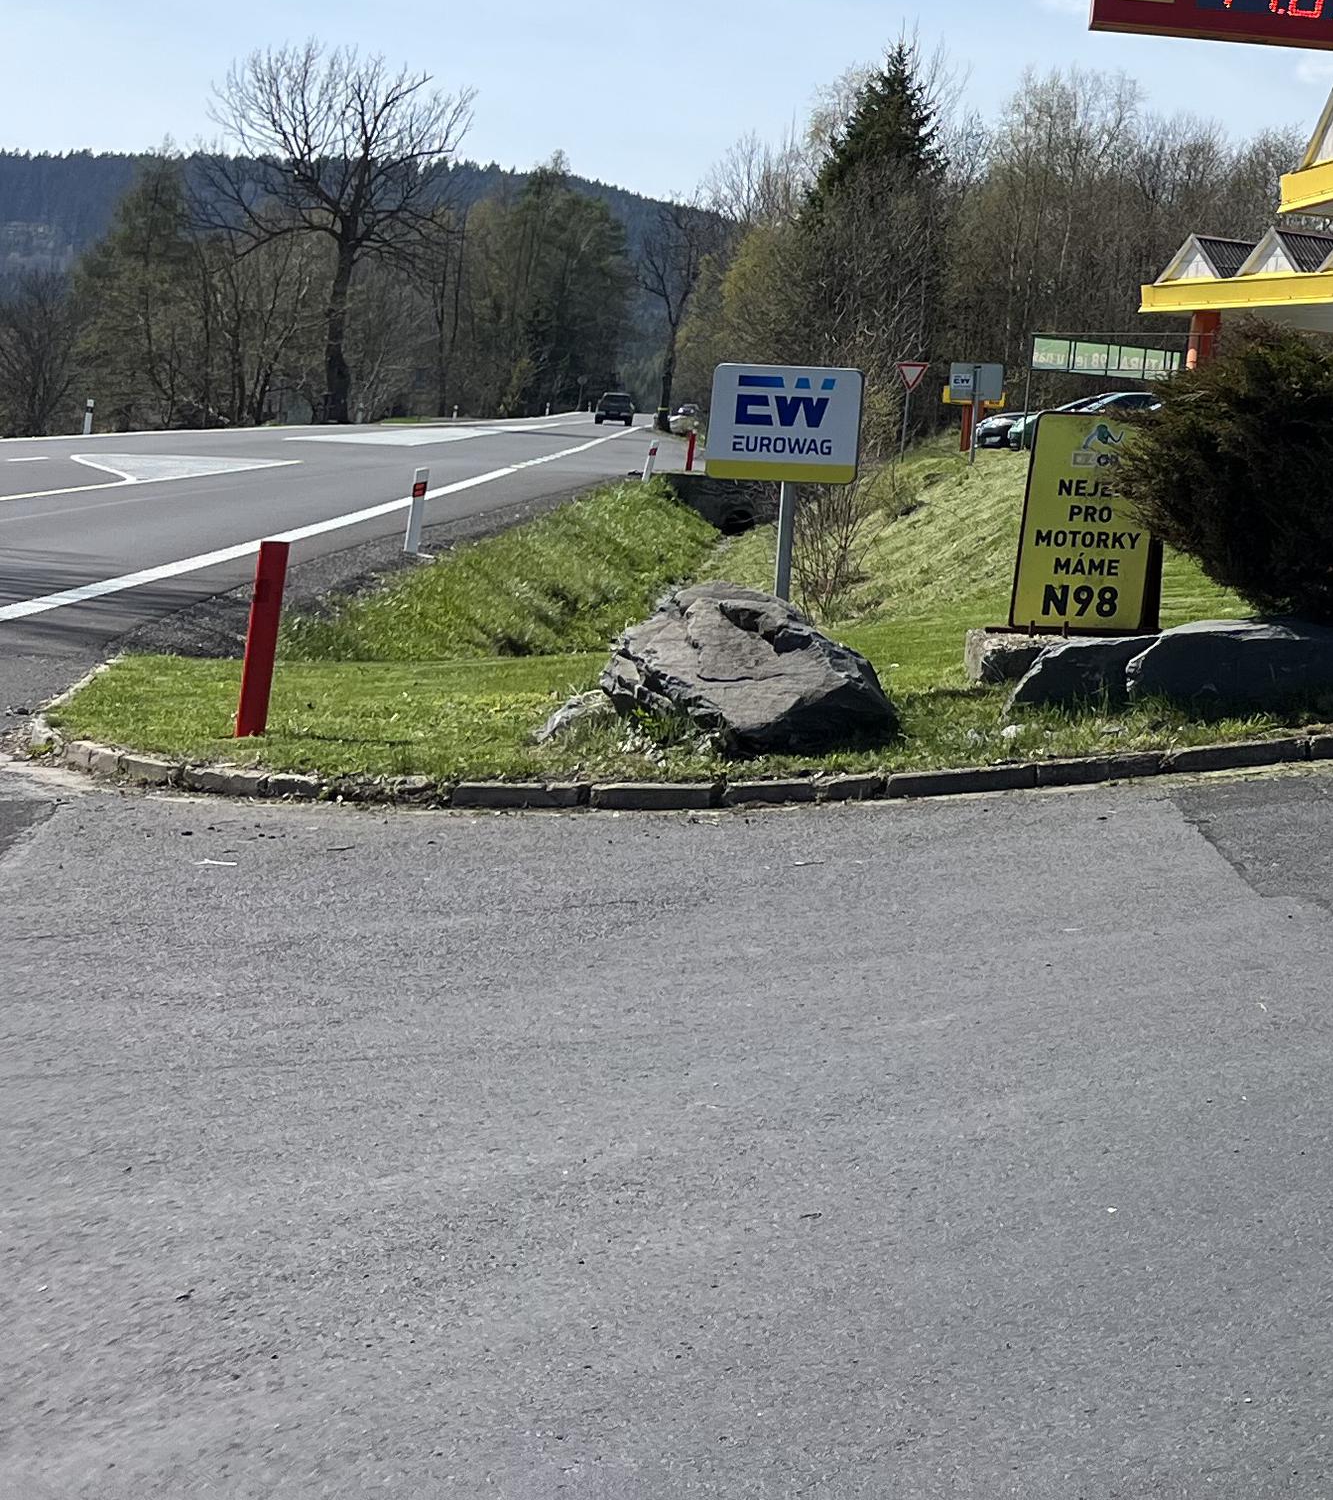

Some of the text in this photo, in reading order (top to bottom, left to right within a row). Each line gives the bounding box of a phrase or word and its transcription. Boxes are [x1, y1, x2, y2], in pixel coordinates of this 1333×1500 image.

[735, 375, 836, 428] EW
[732, 435, 832, 456] EUROWAG
[1068, 505, 1112, 523] PRO
[1034, 529, 1141, 550] MOTORKY
[1053, 552, 1120, 576] MÁME
[1041, 584, 1119, 618] N98
